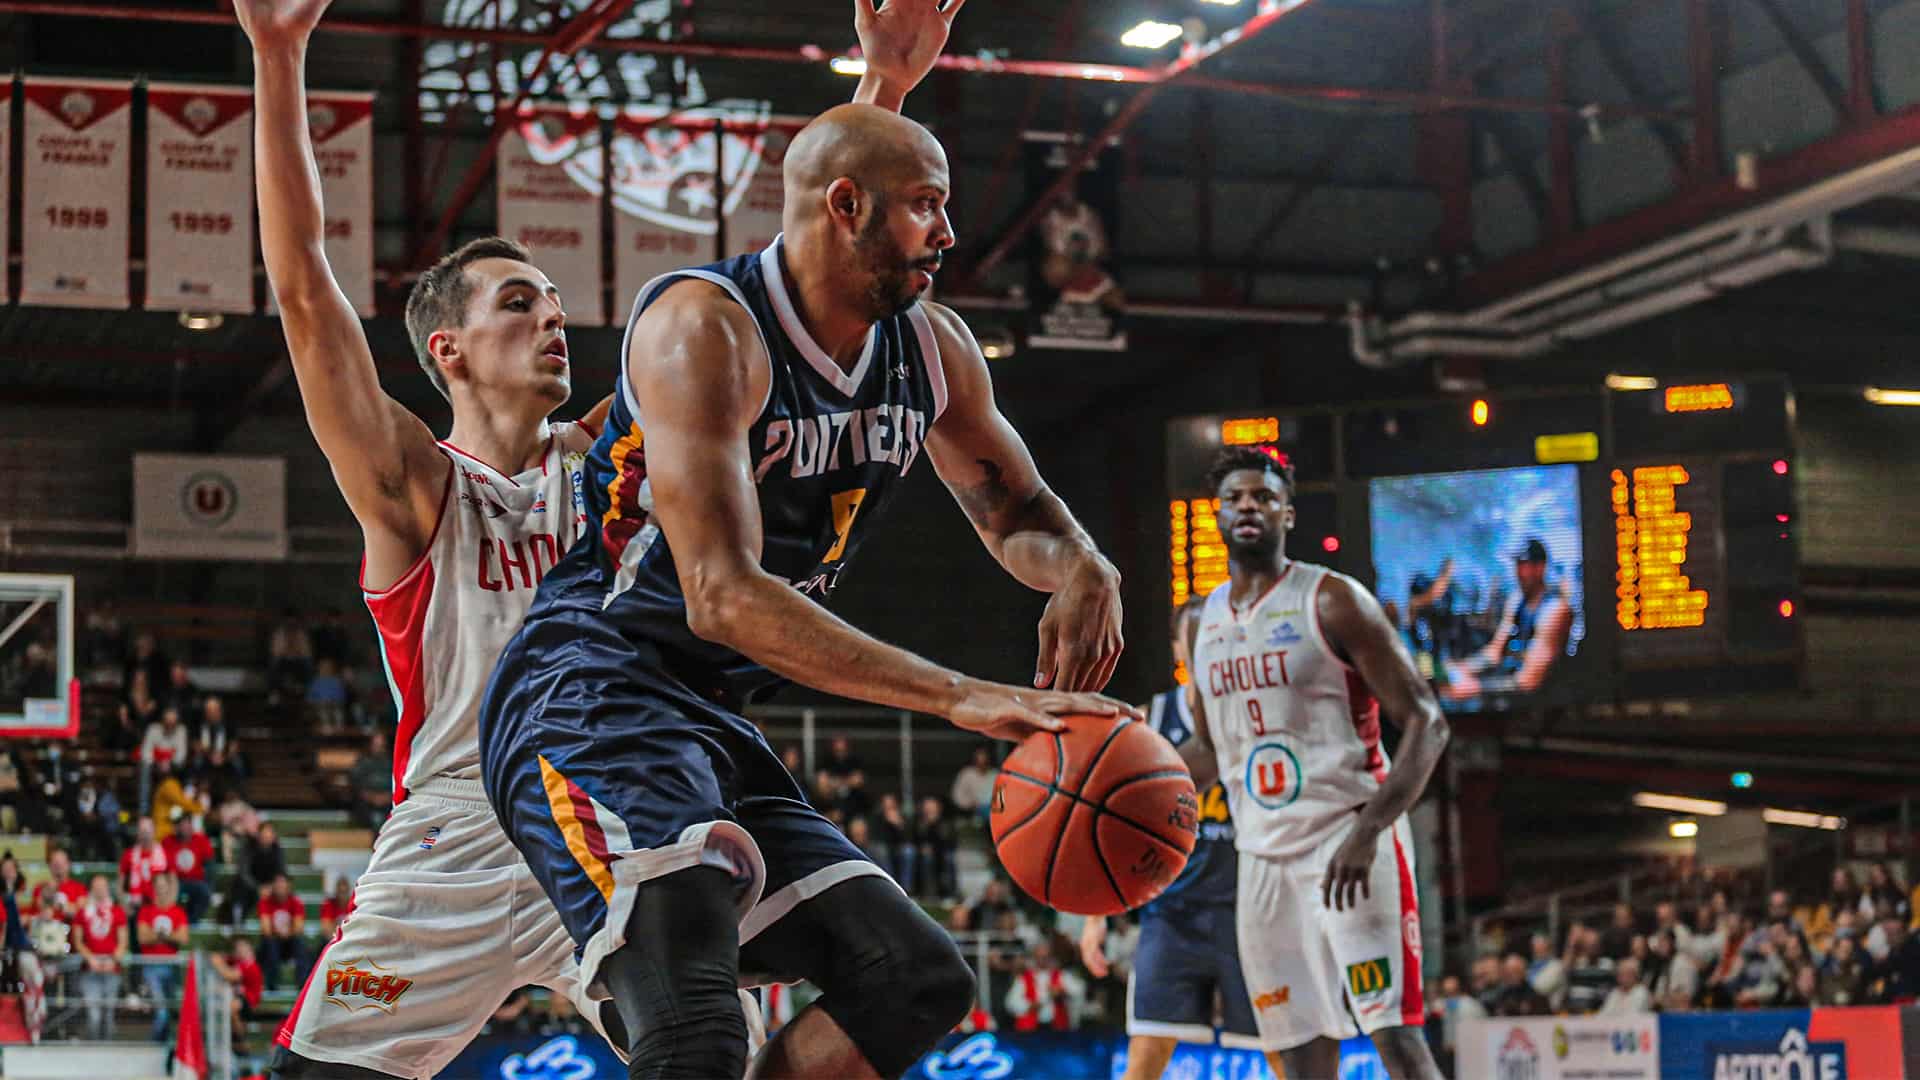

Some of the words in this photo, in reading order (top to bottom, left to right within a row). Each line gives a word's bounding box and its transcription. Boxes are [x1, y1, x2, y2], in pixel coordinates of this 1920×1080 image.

[1209, 650, 1290, 698] CHOLET
[1247, 699, 1265, 737] 9
[1257, 761, 1287, 797] U
[326, 966, 415, 1006] PITCH
